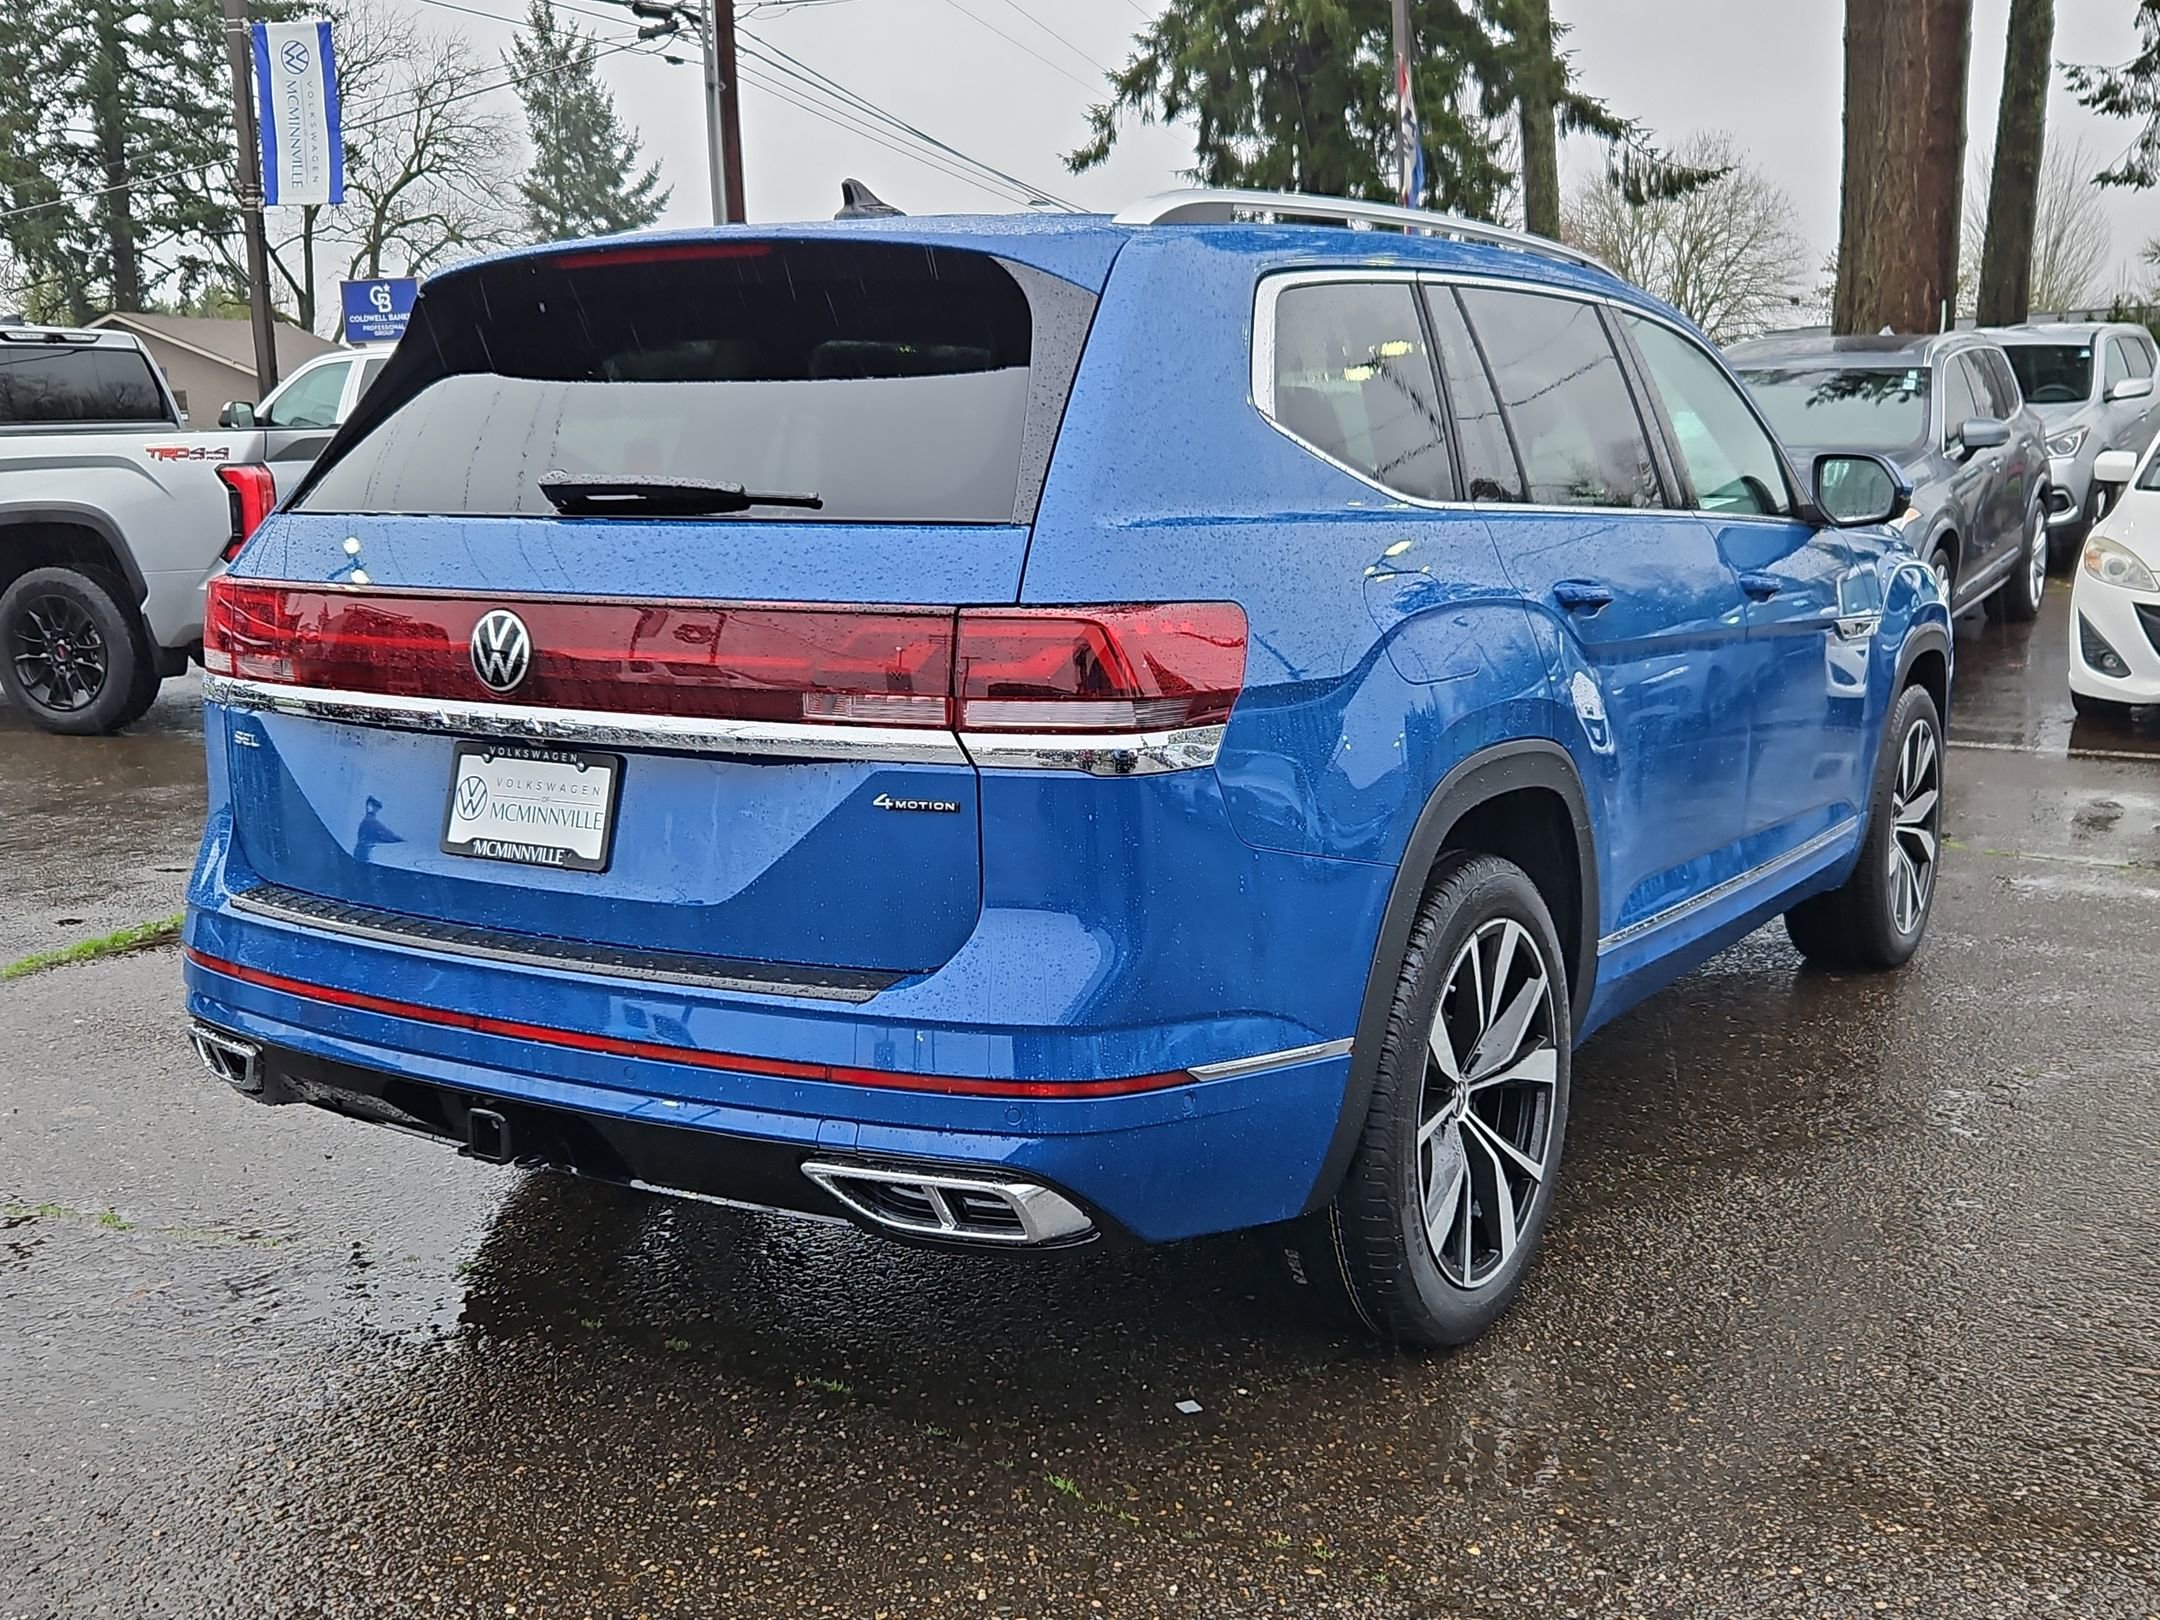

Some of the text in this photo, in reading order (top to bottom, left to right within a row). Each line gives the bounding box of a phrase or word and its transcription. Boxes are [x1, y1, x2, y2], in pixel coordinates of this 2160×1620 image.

[285, 80, 304, 189] MCMINNVILLE
[307, 81, 319, 184] VOLKSWAGEN
[349, 314, 388, 323] COLDWELL
[145, 447, 190, 461] TRD
[234, 730, 261, 747] SEL
[488, 746, 579, 763] VOLKSWAGEN
[497, 777, 601, 797] VOLKSWAGEN
[489, 802, 604, 831] MCMINNVILLE
[473, 840, 566, 866] MCMINNVILLE
